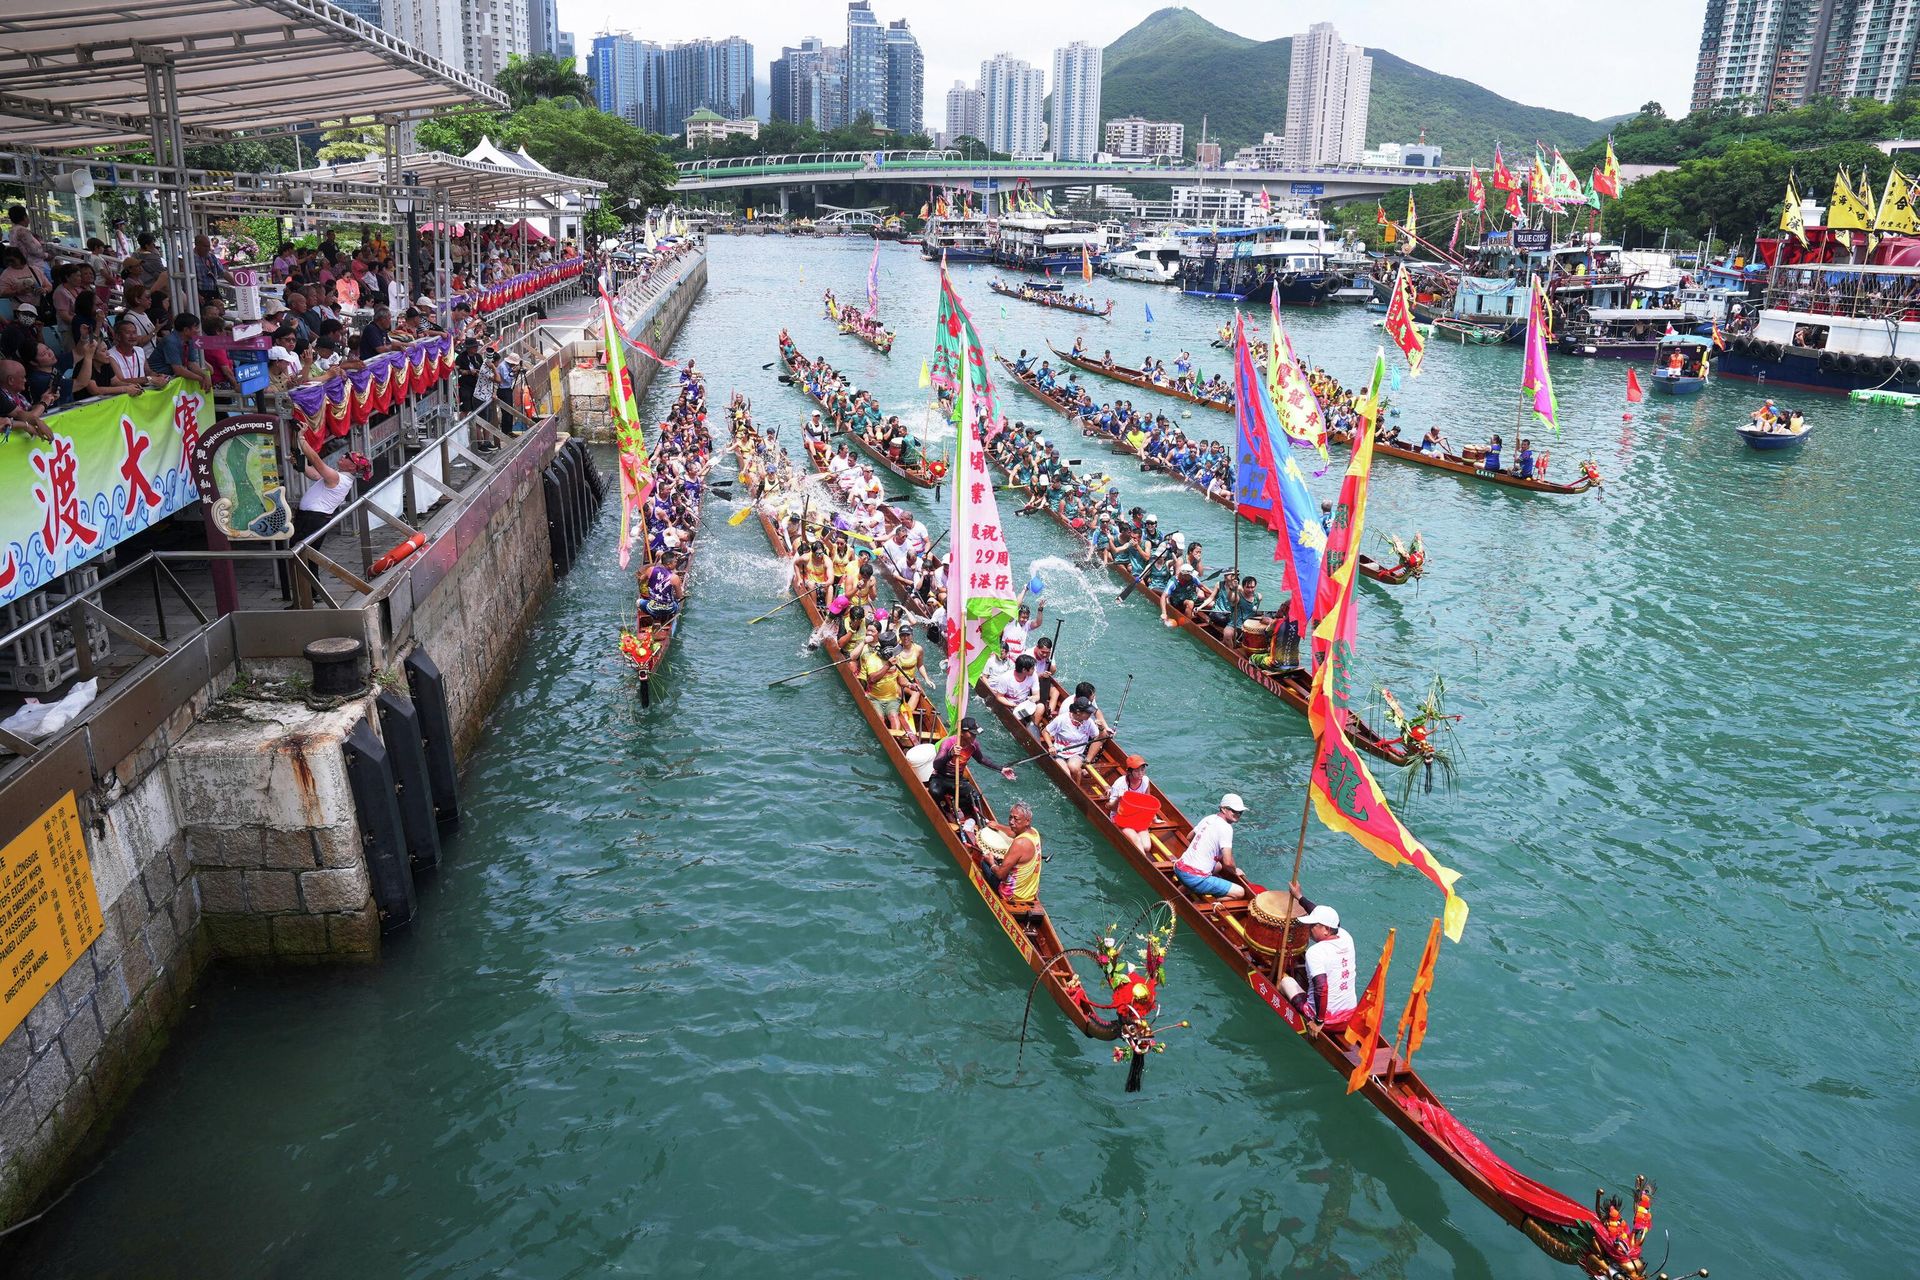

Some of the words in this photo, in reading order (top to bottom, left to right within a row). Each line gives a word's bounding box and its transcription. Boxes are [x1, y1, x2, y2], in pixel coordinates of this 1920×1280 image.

[1518, 234, 1532, 242] BLUE
[203, 424, 236, 449] Sightseeing
[236, 422, 265, 431] Sampan
[266, 422, 274, 430] 5
[3, 875, 11, 889] LIE
[13, 850, 39, 879] ALONGSIDE
[11, 876, 29, 898] EXCEPT
[29, 864, 42, 881] WHEN
[76, 848, 89, 884] 告示
[5, 902, 37, 939] PASSENGERS
[38, 890, 49, 906] AND
[6, 910, 13, 921] IN
[13, 885, 38, 915] EMBARKING
[38, 877, 46, 891] OR
[4, 977, 27, 1004] DIRECTOR
[26, 967, 33, 981] OF
[32, 950, 49, 974] MARINE
[12, 966, 19, 978] BY
[18, 949, 35, 972] ORDER
